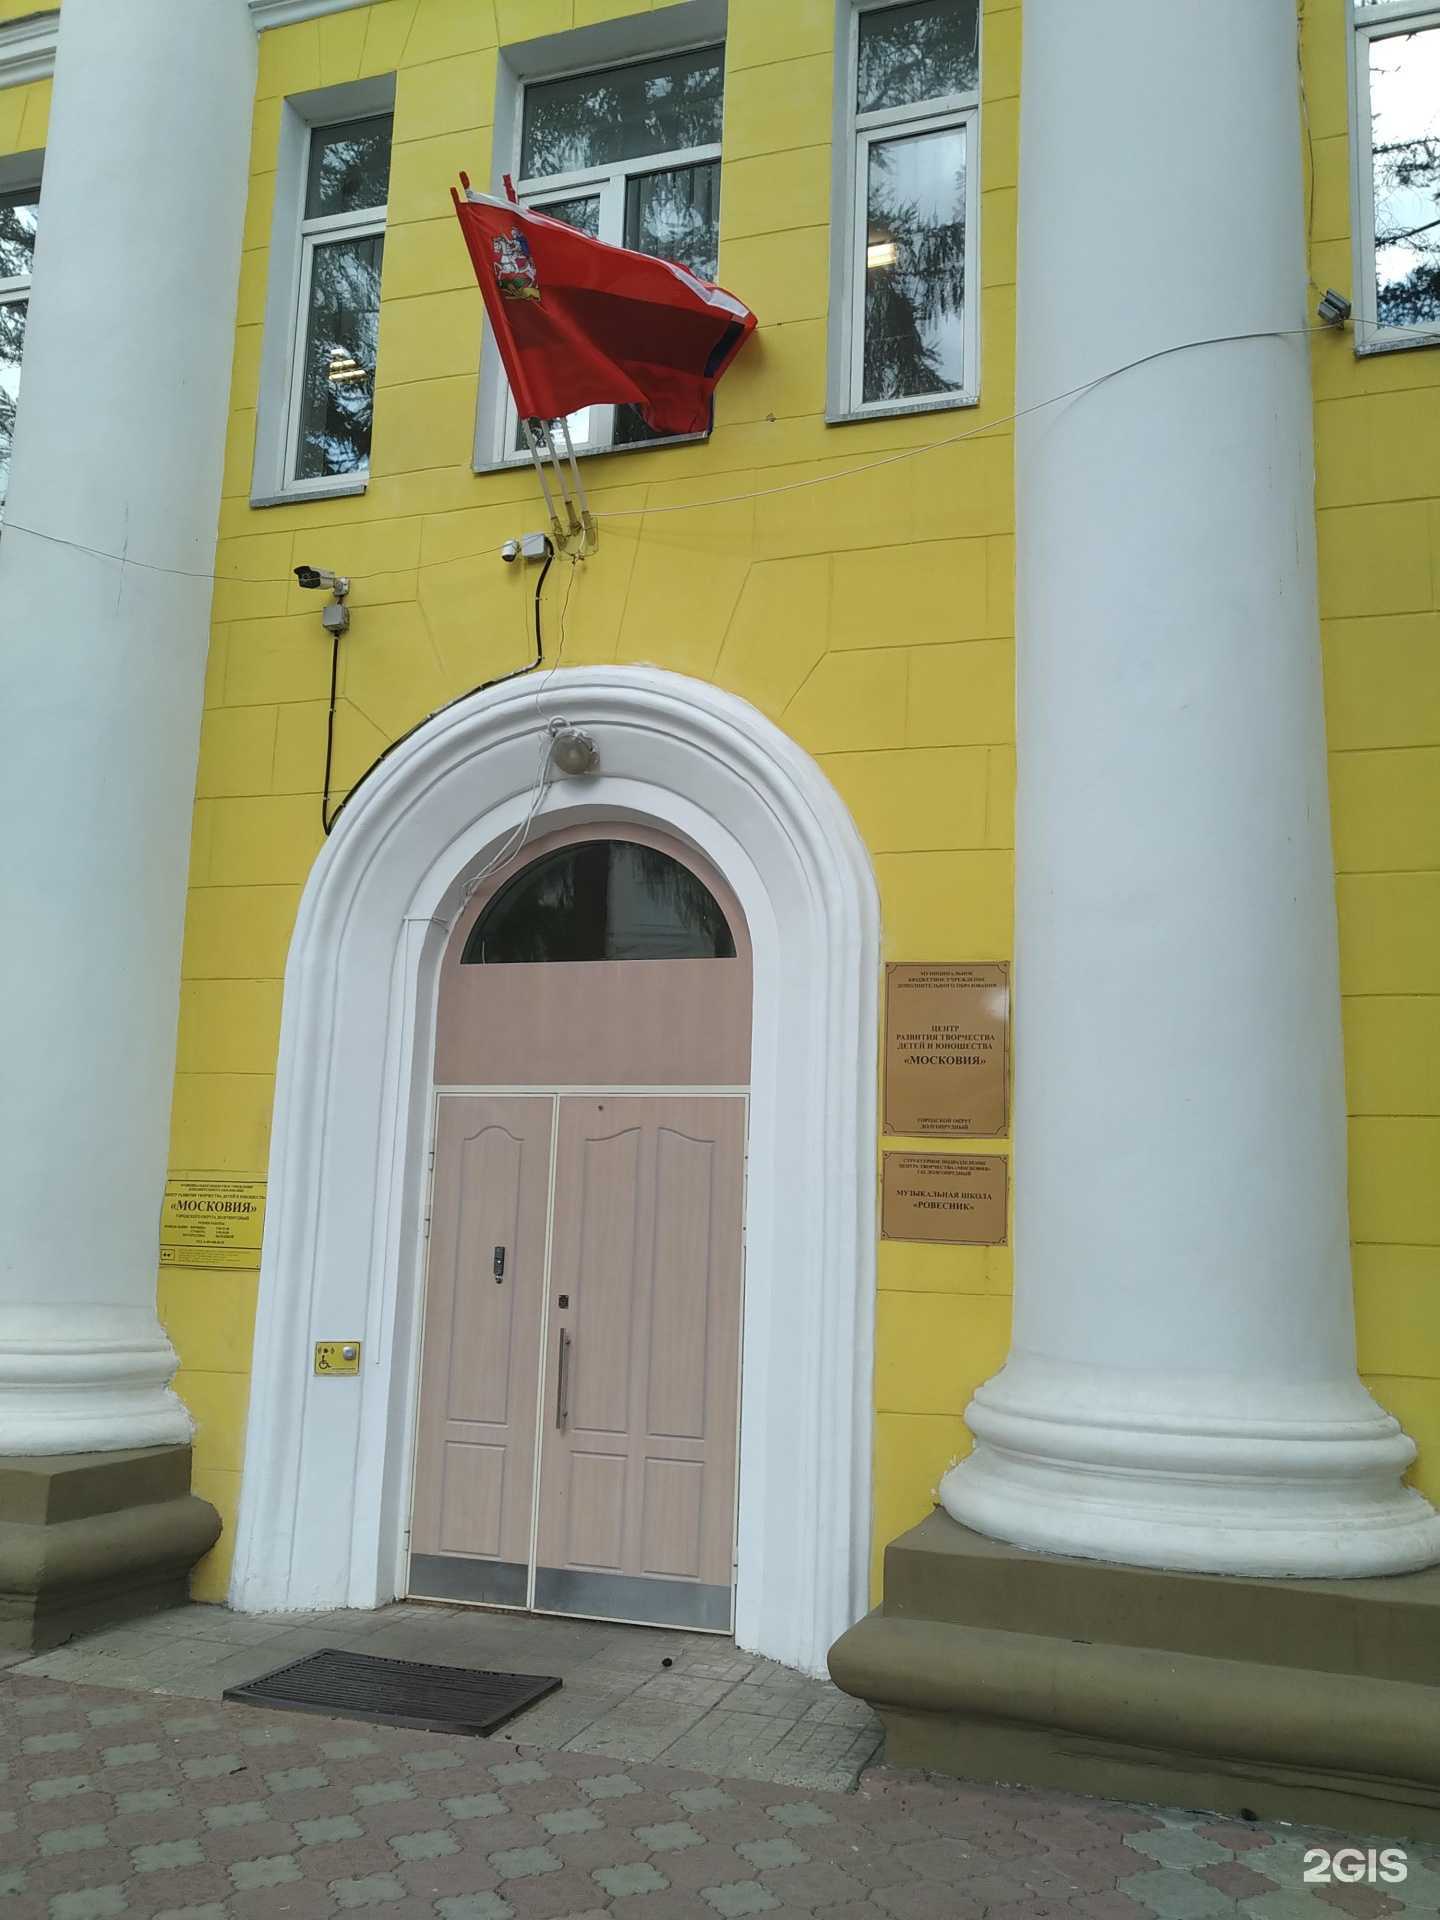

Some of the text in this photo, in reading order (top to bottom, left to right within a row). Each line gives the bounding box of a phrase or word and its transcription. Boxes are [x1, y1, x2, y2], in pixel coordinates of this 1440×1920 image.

[896, 1033, 995, 1041] РАЗВИТИЯ ТВОРЧЕСТВА
[897, 1042, 925, 1050] ДЕТЕЙ
[935, 1042, 993, 1050] ЮНОШЕСТВА
[904, 1055, 986, 1065] «МОСКОВИЯ»
[896, 1189, 992, 1200] МУЗЫКАЛЬНАЯ ШКОЛА
[171, 1200, 257, 1213] «МОСКОВИЯ»
